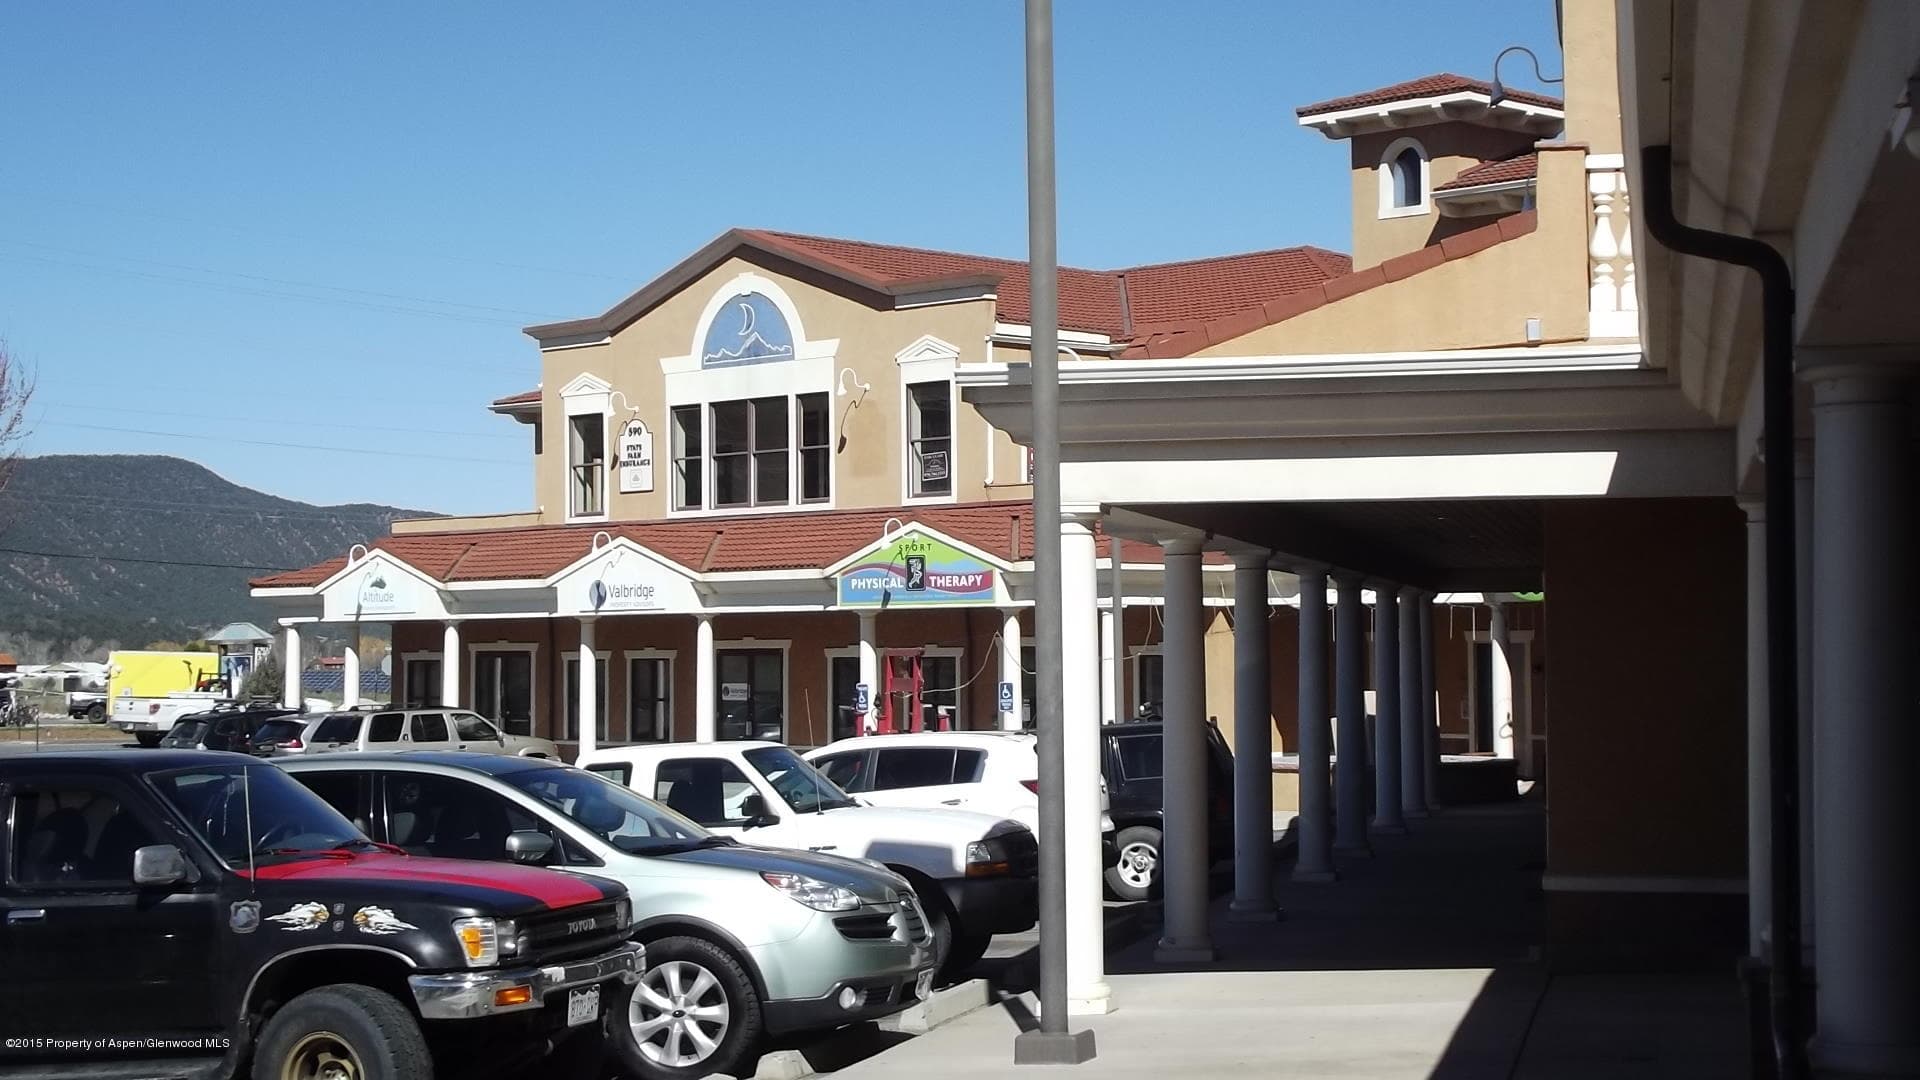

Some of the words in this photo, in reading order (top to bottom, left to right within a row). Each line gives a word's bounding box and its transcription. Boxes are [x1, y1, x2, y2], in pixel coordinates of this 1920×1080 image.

[628, 426, 642, 437] 590
[626, 444, 642, 452] STATE
[898, 543, 932, 552] SPORT
[851, 576, 904, 590] PHYSICAL
[928, 574, 984, 588] THERAPY
[362, 590, 395, 602] Altitude
[608, 583, 655, 600] Valbridge
[567, 918, 597, 935] TOYOTA
